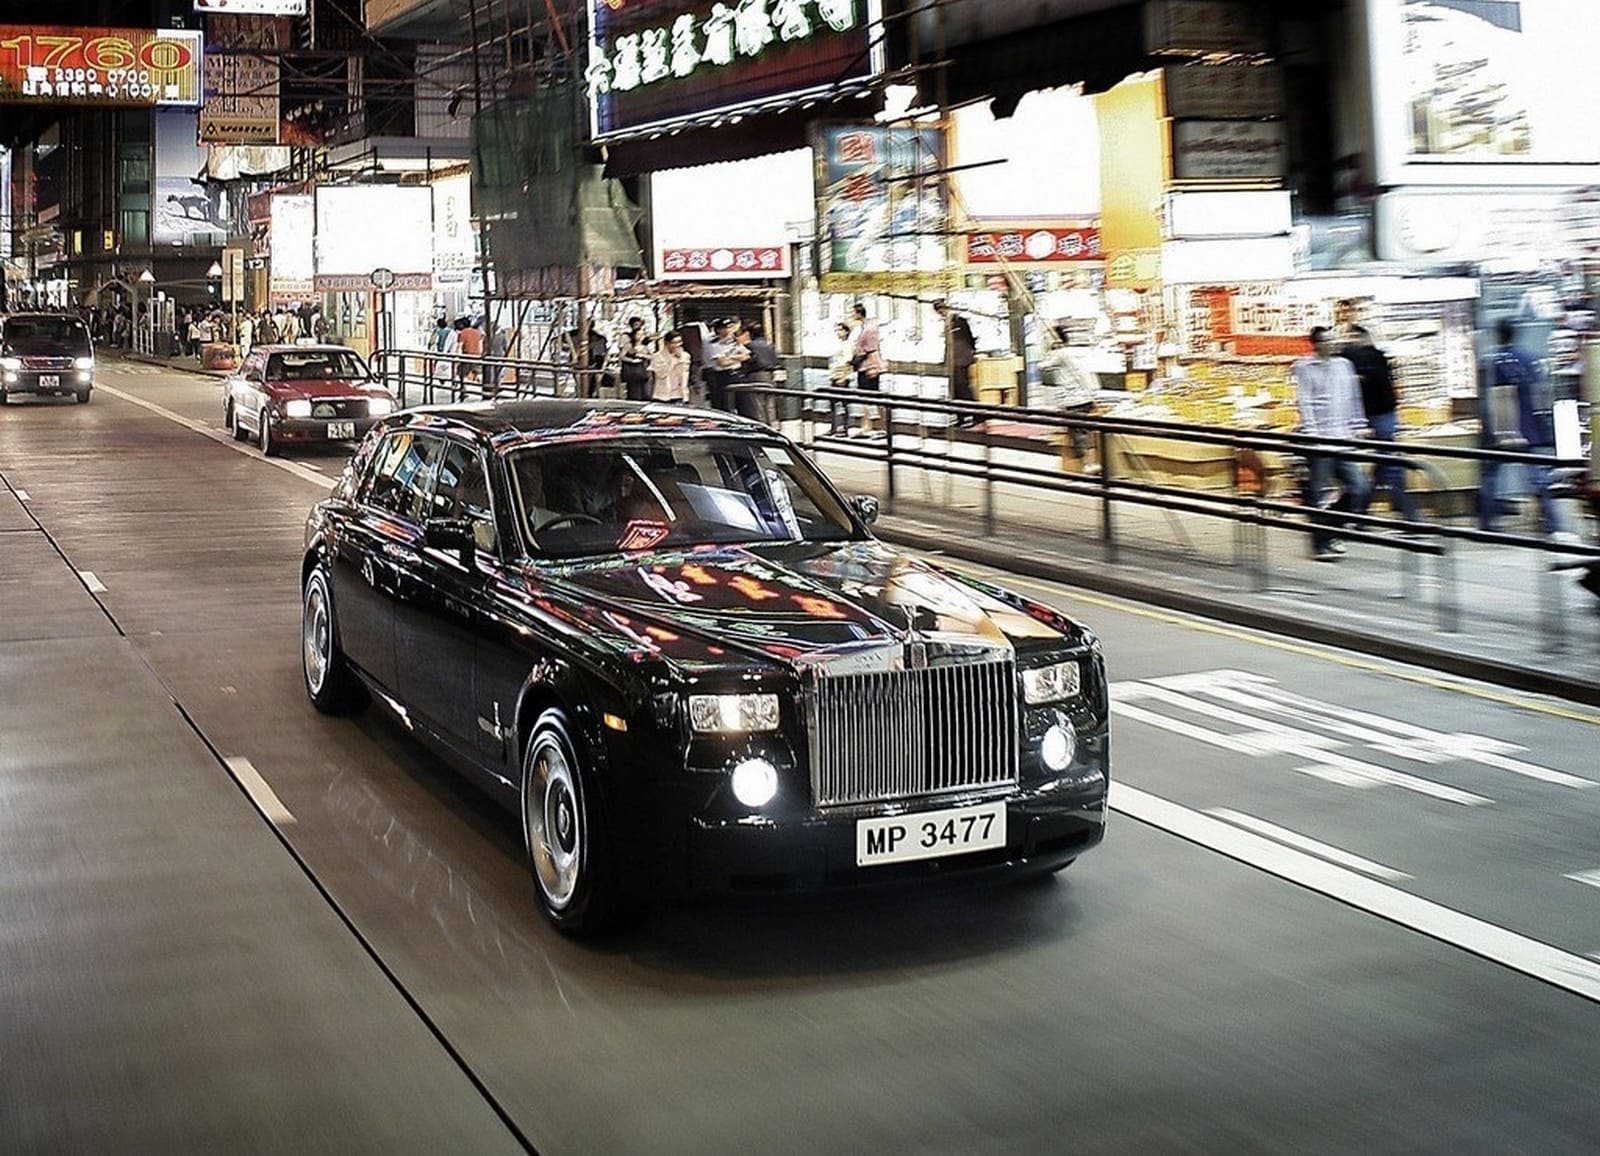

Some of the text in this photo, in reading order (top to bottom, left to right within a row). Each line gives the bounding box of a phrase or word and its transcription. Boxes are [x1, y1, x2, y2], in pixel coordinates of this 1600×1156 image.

[1, 35, 192, 71] 1760
[107, 68, 149, 83] 0700
[866, 812, 997, 855] MP 3477
